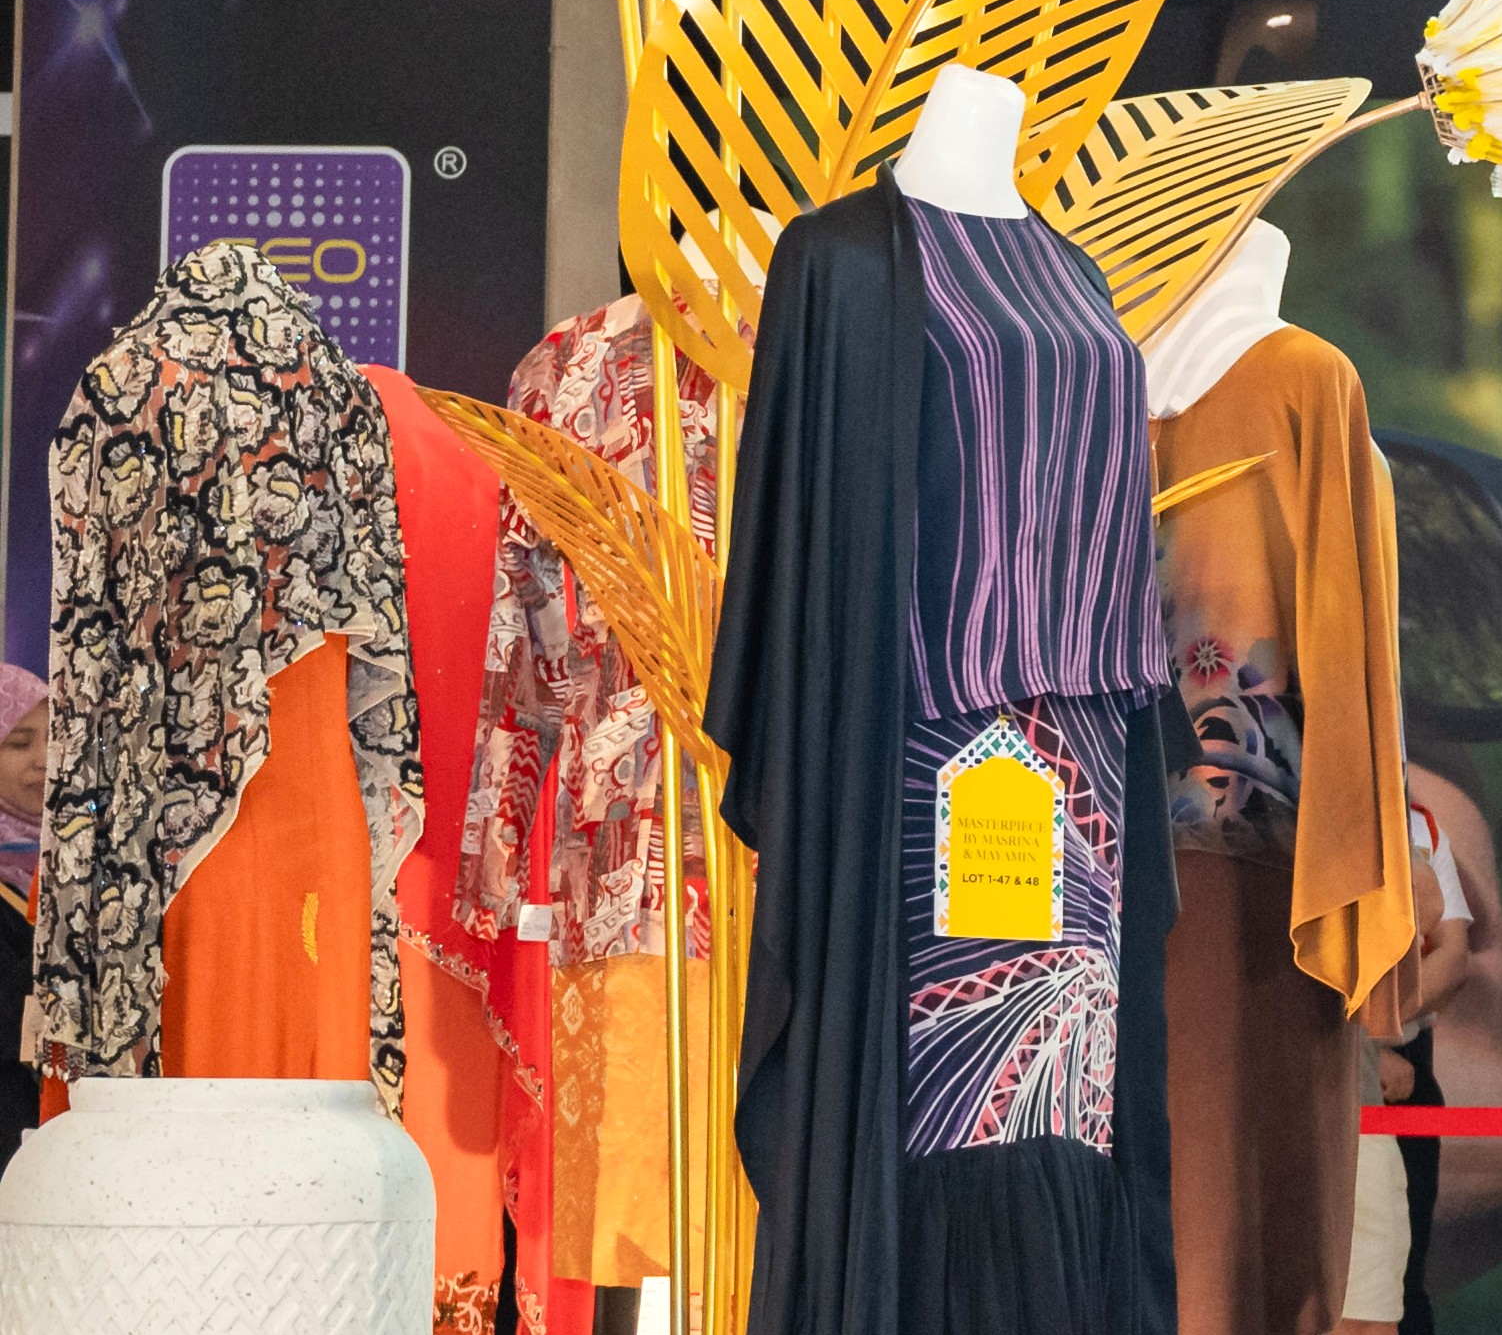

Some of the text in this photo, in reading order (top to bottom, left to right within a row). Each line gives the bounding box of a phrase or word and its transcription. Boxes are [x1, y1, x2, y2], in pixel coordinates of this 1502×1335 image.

[209, 237, 366, 283] EO
[958, 817, 1044, 833] MASTERPIECE
[963, 833, 1040, 848] BY MASRINA
[963, 849, 1037, 863] & MAYAMIN
[962, 873, 1040, 886] LOT 1-47 & 48
